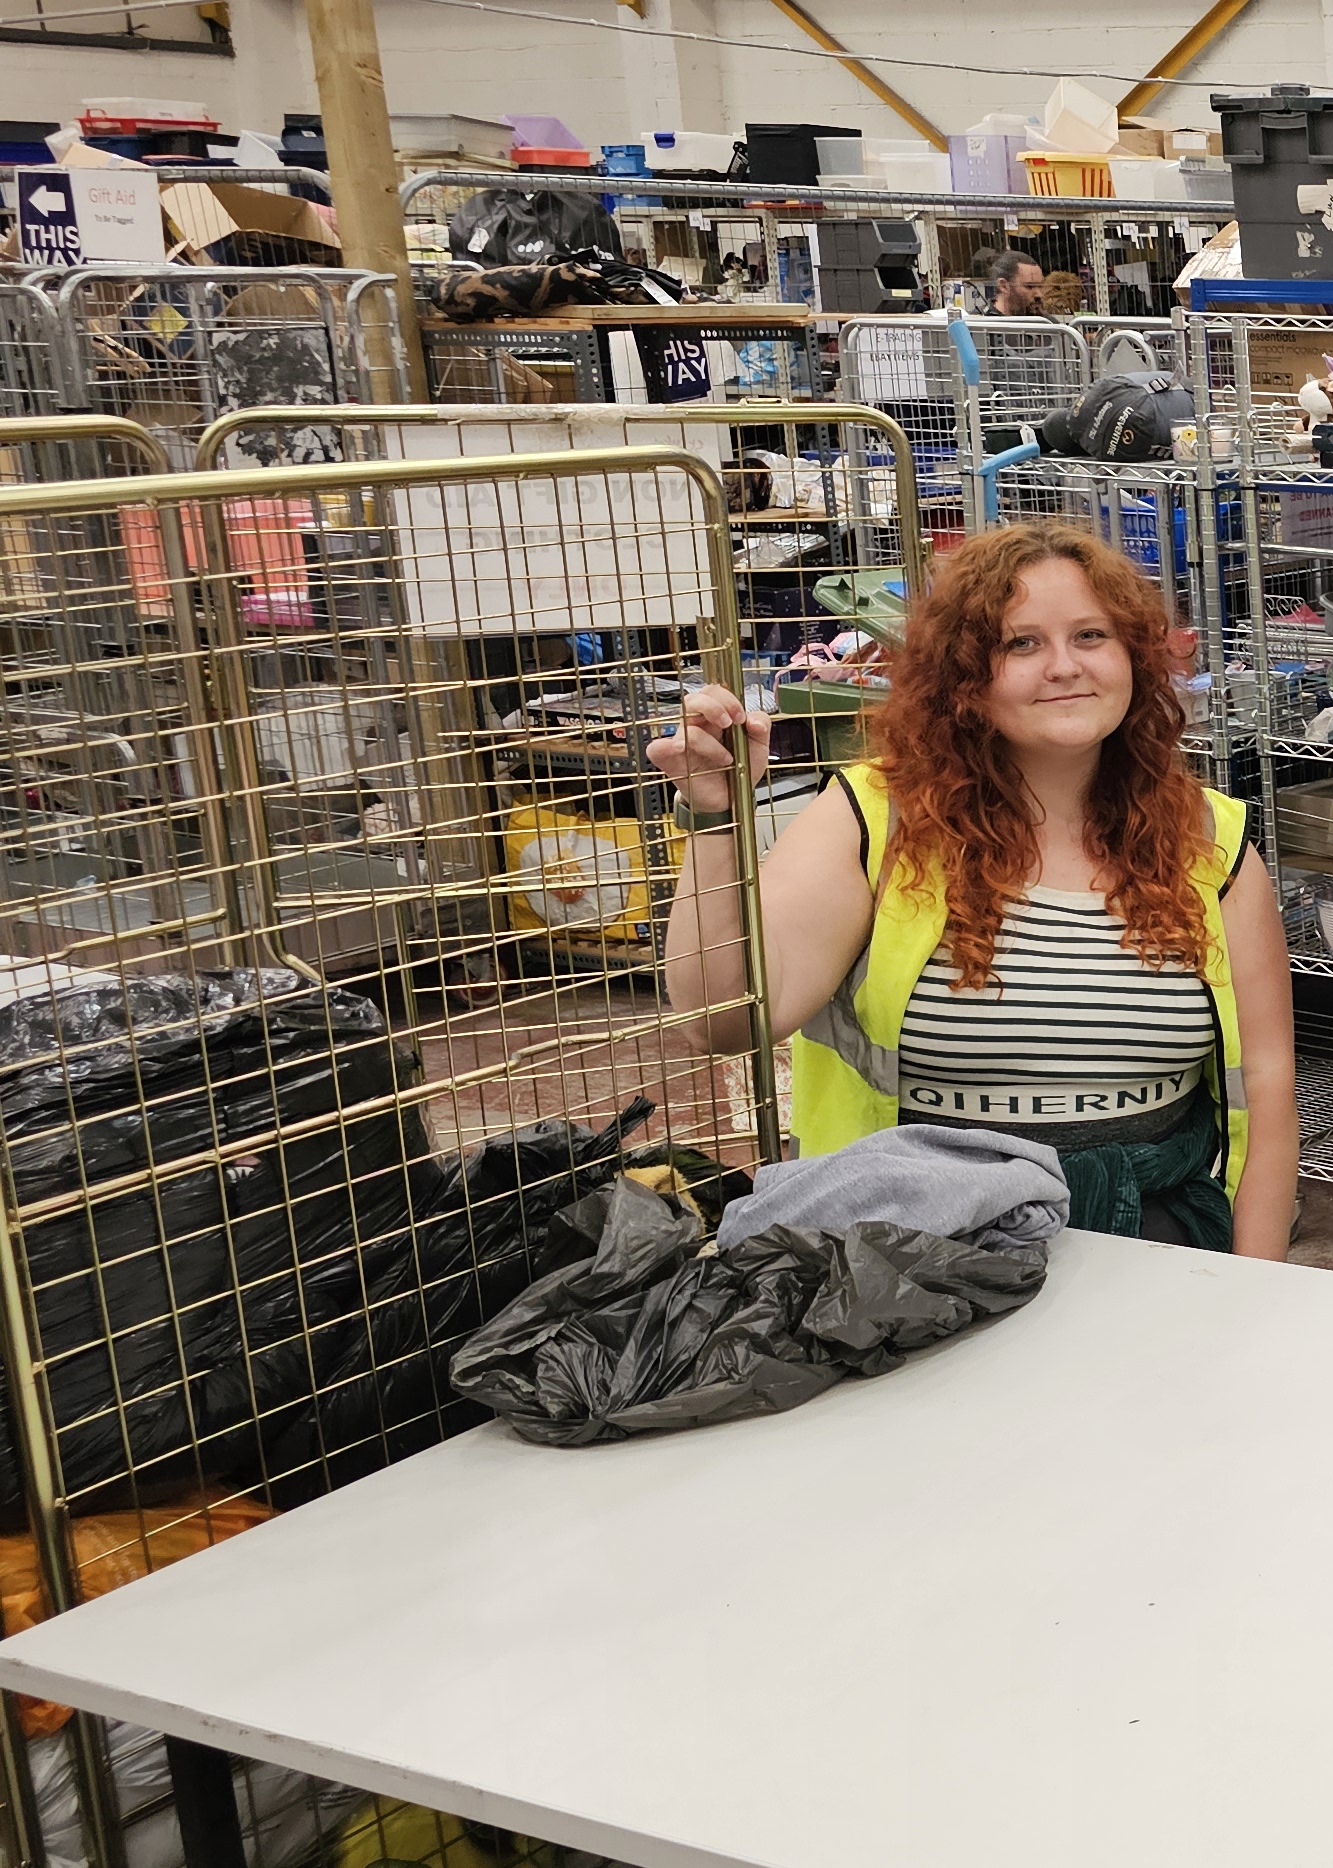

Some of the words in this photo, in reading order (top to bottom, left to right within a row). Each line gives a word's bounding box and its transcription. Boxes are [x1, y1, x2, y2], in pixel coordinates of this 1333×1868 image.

[88, 187, 113, 204] Gift
[115, 189, 136, 206] Aid
[25, 224, 81, 249] THIS
[24, 248, 84, 268] WAY
[1249, 331, 1297, 343] essentials
[1249, 344, 1285, 354] compact
[1106, 406, 1135, 457] LIFEVENTURE
